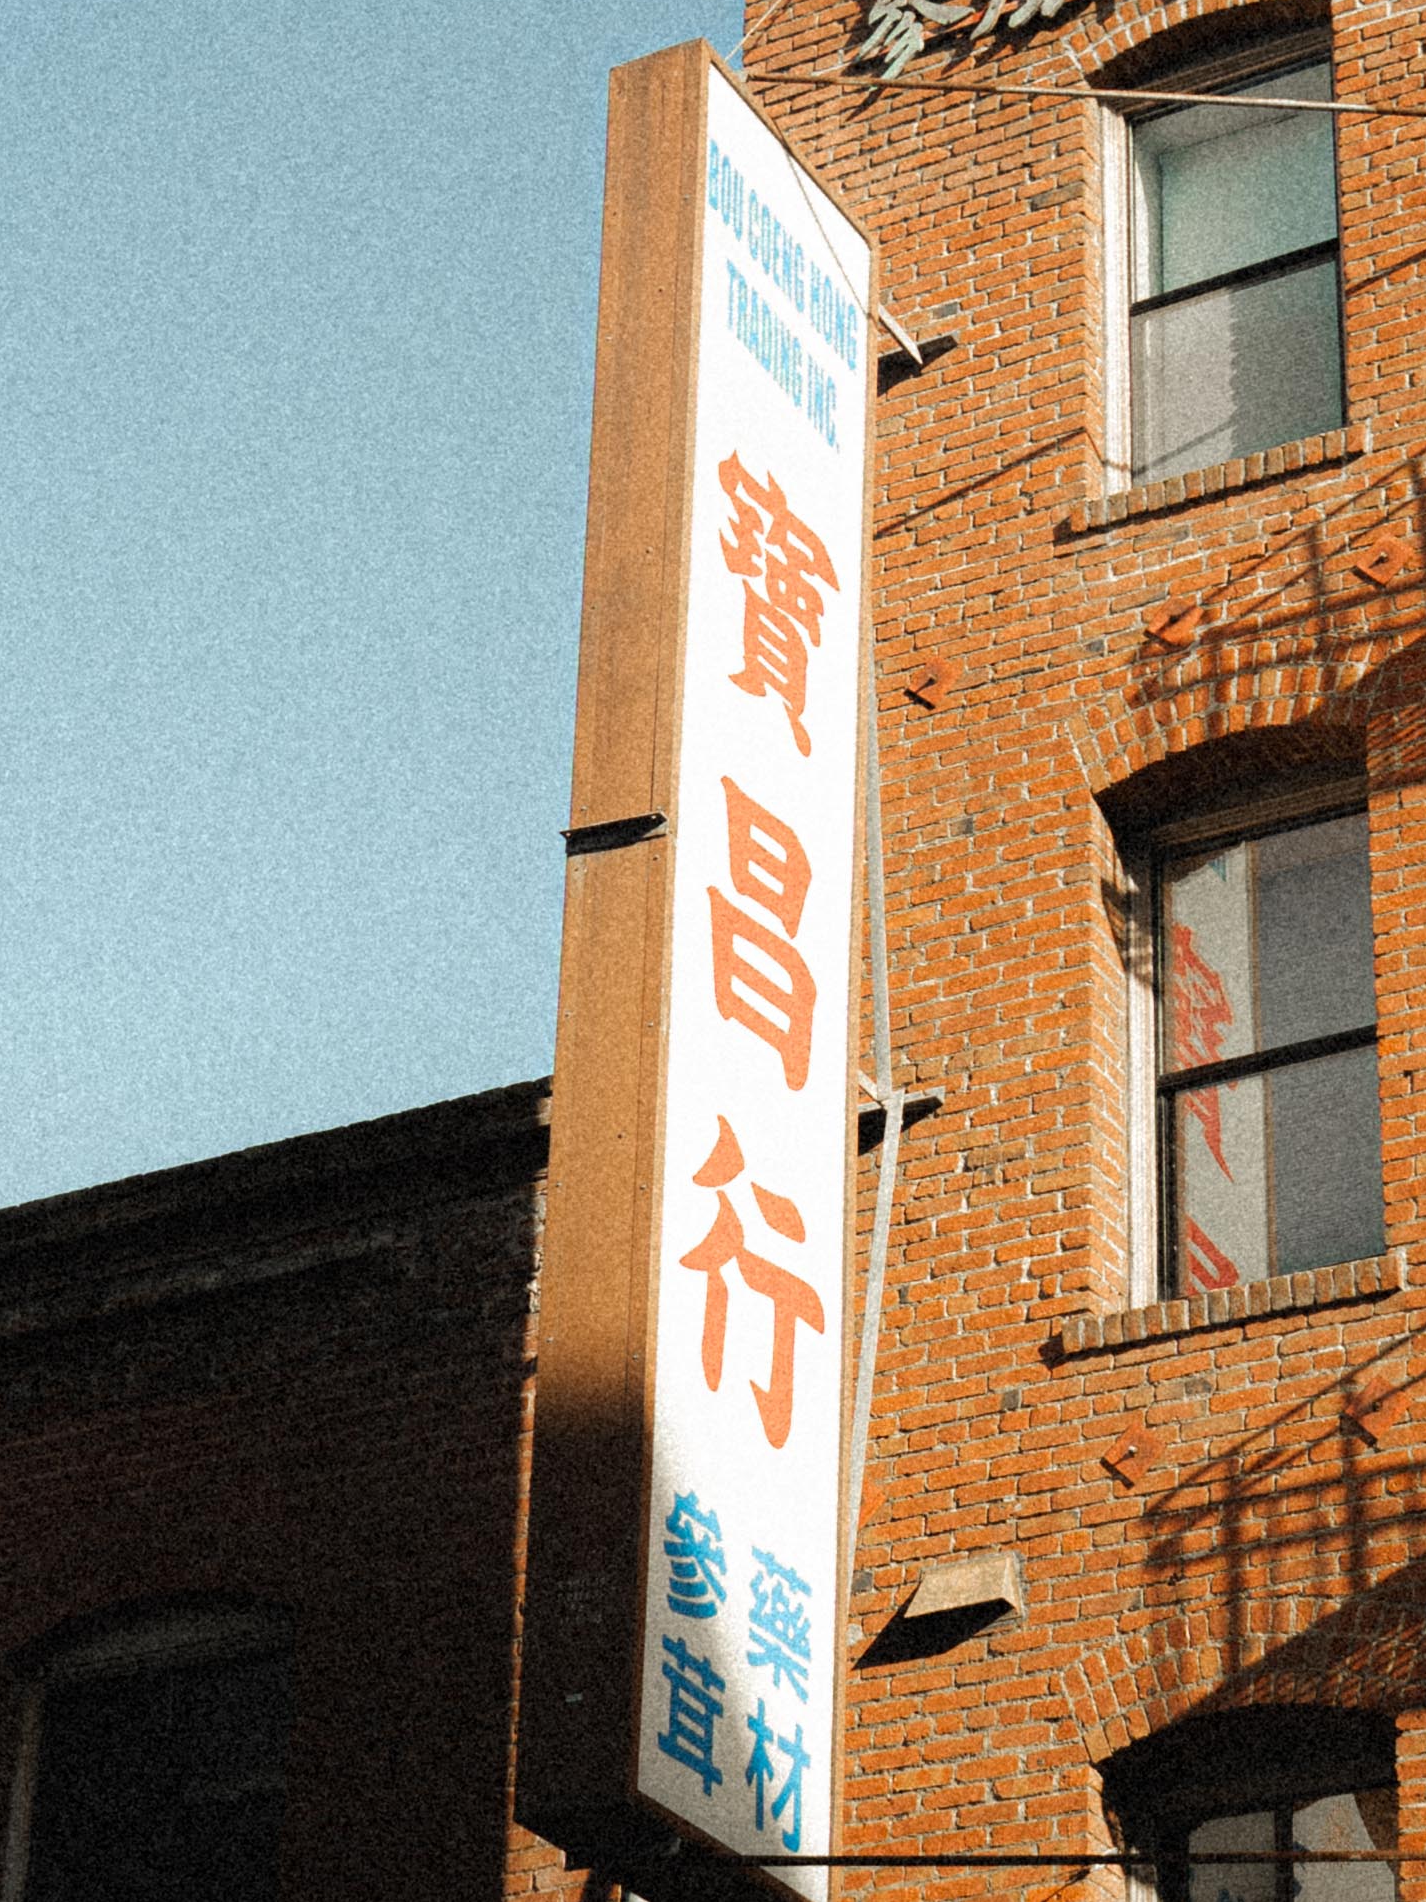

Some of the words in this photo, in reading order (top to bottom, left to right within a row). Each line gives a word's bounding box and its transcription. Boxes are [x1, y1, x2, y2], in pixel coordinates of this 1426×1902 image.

[707, 137, 745, 243] BOU
[747, 188, 806, 315] COENG
[809, 260, 859, 373] HONG
[725, 256, 803, 409] TRADING
[806, 353, 841, 455] INC.
